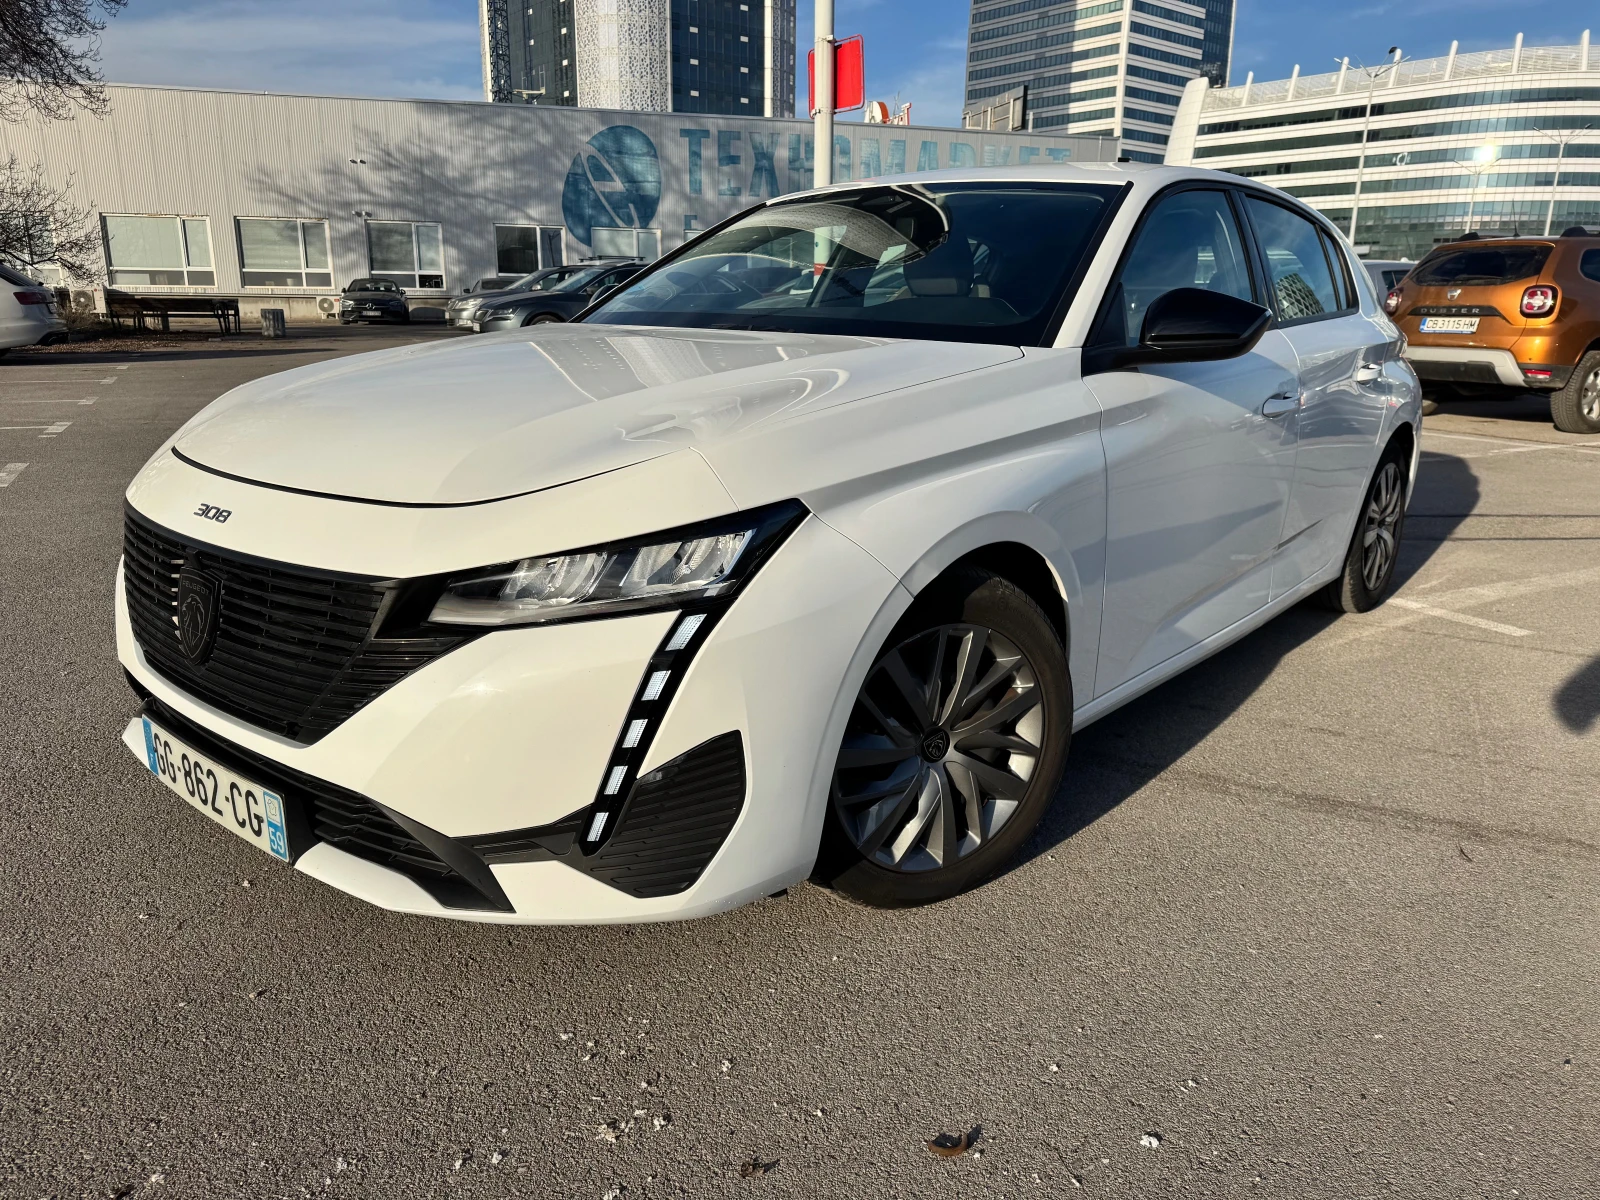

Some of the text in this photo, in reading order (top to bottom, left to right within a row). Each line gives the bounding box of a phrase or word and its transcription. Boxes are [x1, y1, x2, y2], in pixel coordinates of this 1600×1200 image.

[193, 503, 233, 524] 308
[182, 580, 210, 596] PEUGEOT
[153, 732, 264, 838] GG-862-CG
[268, 826, 285, 854] 59
